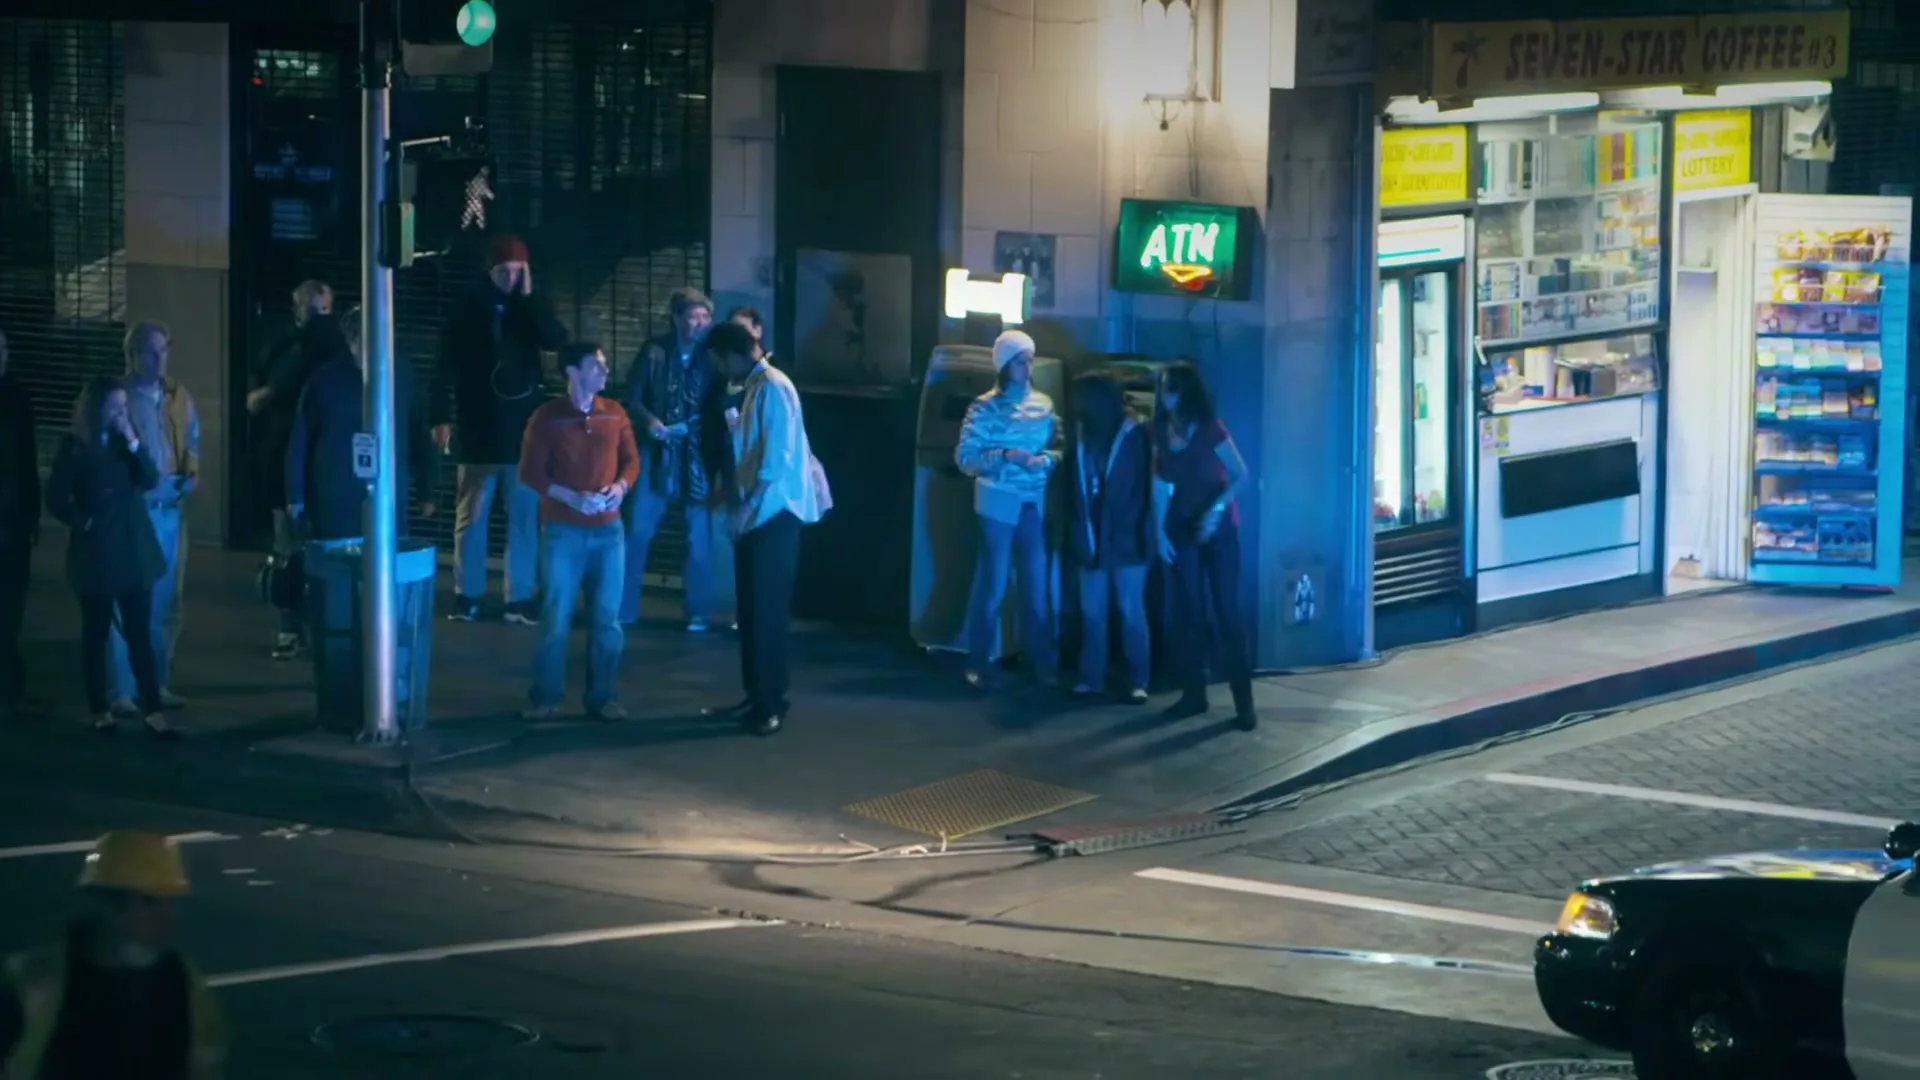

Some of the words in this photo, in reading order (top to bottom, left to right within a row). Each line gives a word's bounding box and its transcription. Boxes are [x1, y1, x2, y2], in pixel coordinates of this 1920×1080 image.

[1505, 27, 1687, 81] SEVEN-STAR
[1701, 25, 1805, 72] COFFEE
[1682, 155, 1733, 177] LOTTERY
[1141, 223, 1220, 267] ATM
